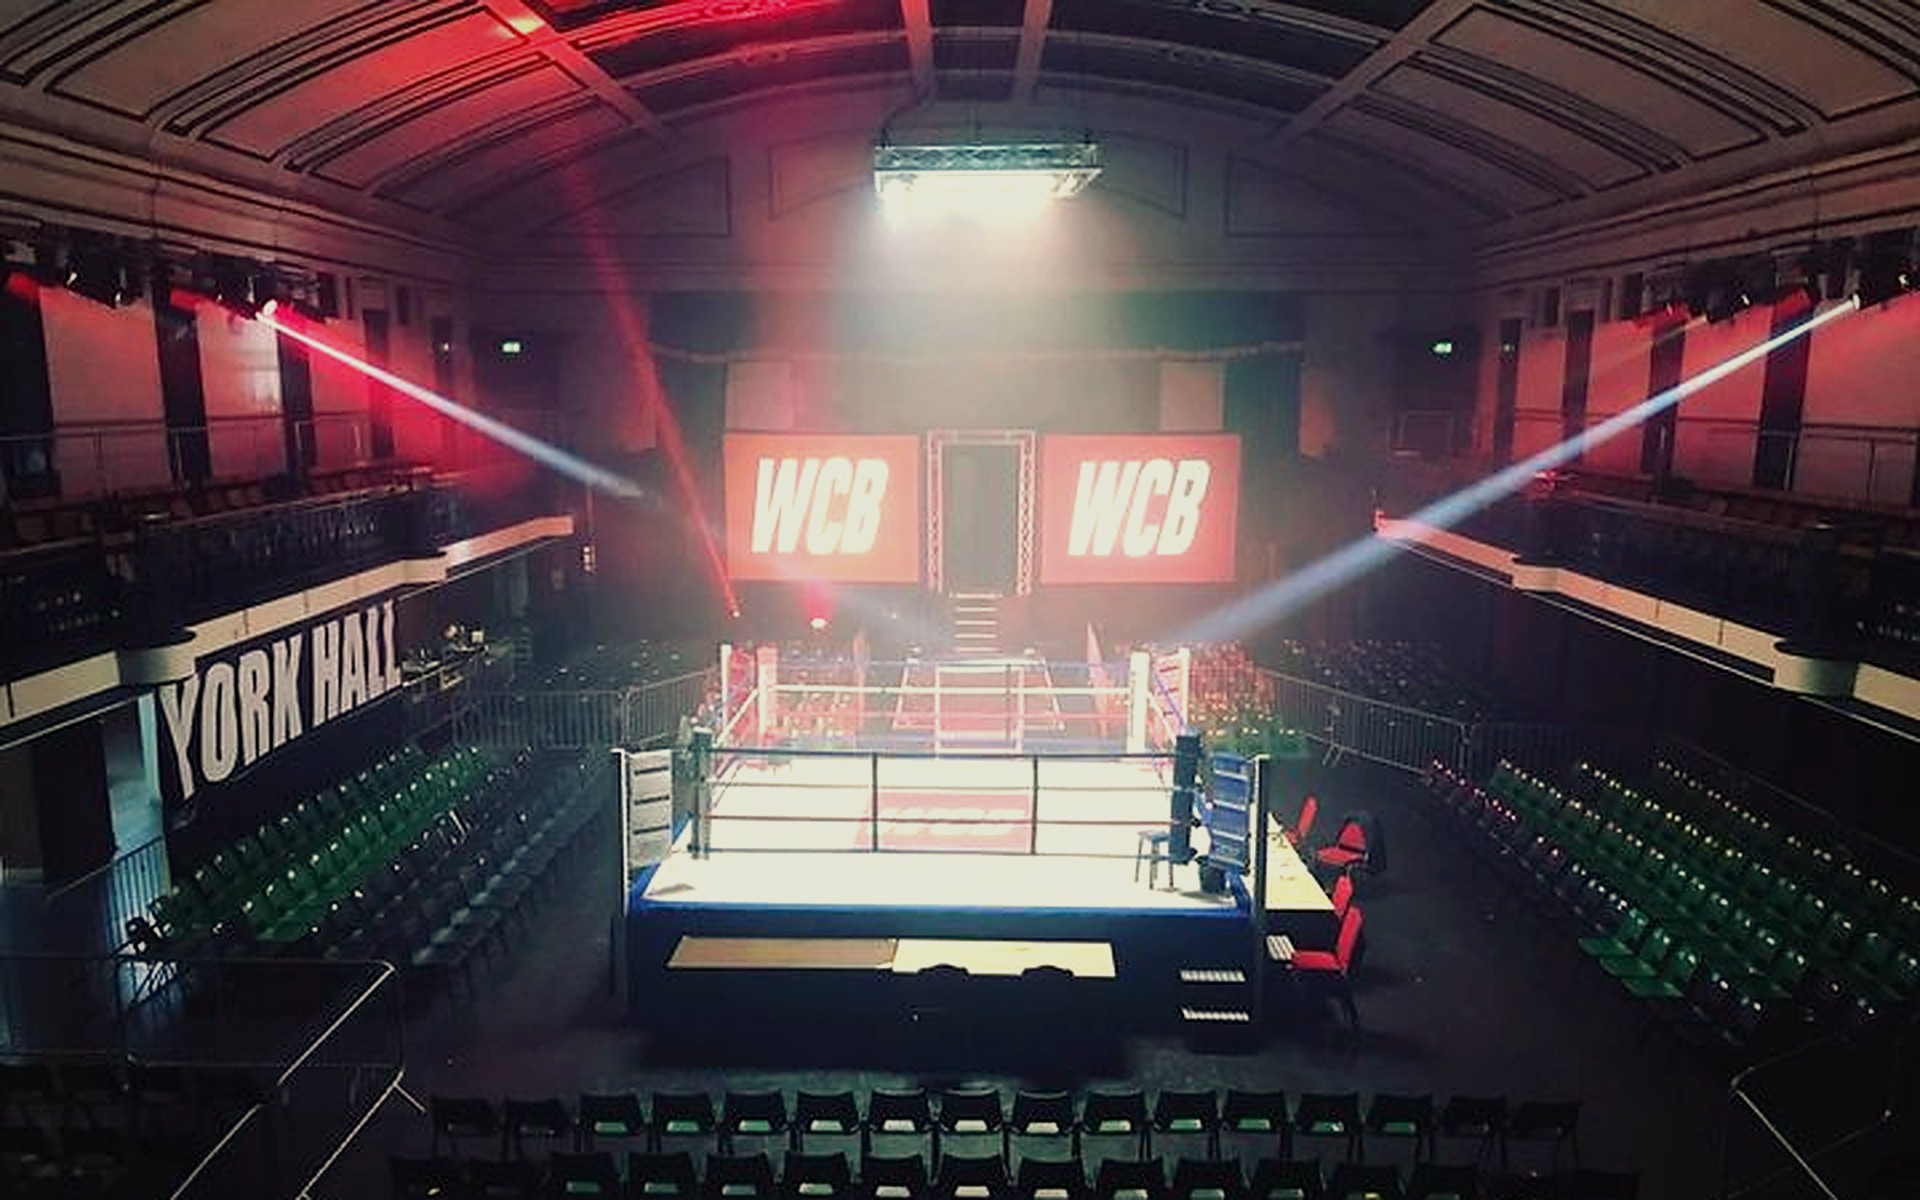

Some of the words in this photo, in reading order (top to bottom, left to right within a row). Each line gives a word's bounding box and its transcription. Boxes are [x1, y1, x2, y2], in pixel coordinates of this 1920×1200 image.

[752, 456, 889, 555] WCB
[1068, 459, 1211, 556] WCB
[159, 630, 302, 800] YORK
[312, 599, 402, 727] HALL
